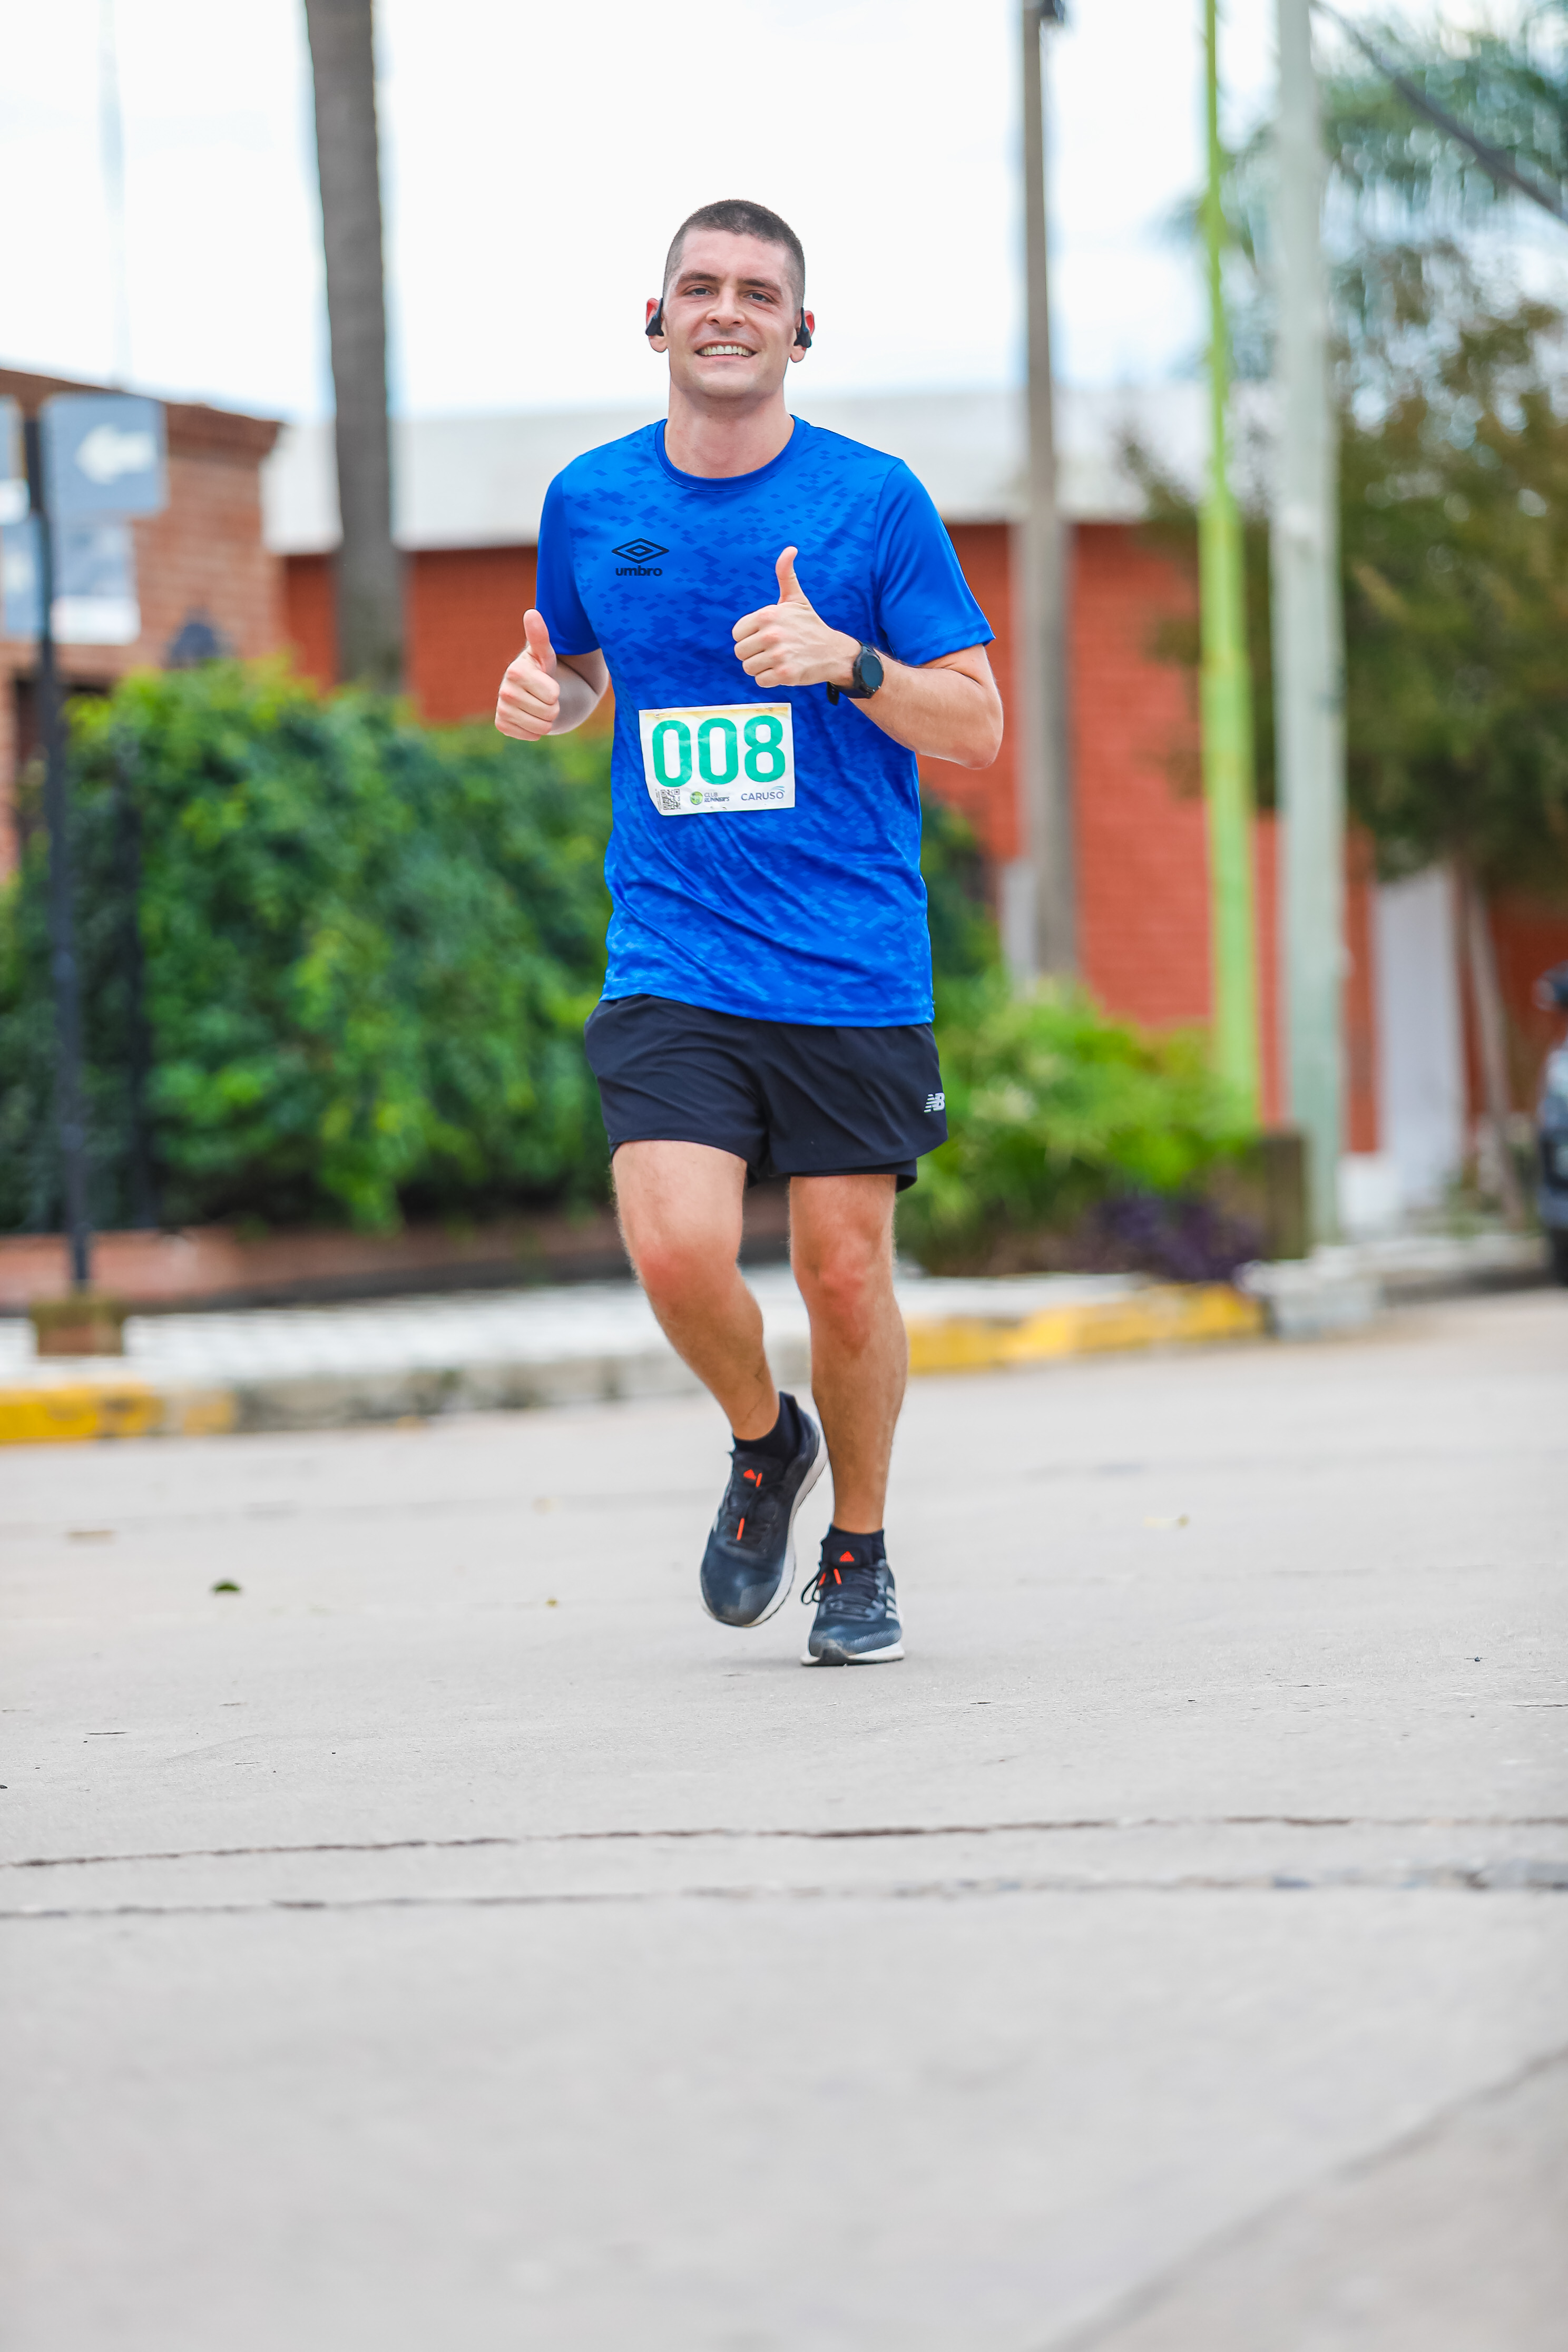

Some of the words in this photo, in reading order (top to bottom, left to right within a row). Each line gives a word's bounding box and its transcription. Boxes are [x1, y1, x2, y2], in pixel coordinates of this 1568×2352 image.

[615, 565, 662, 576] umbro
[652, 716, 785, 787] 008
[741, 791, 784, 800] CARUSO
